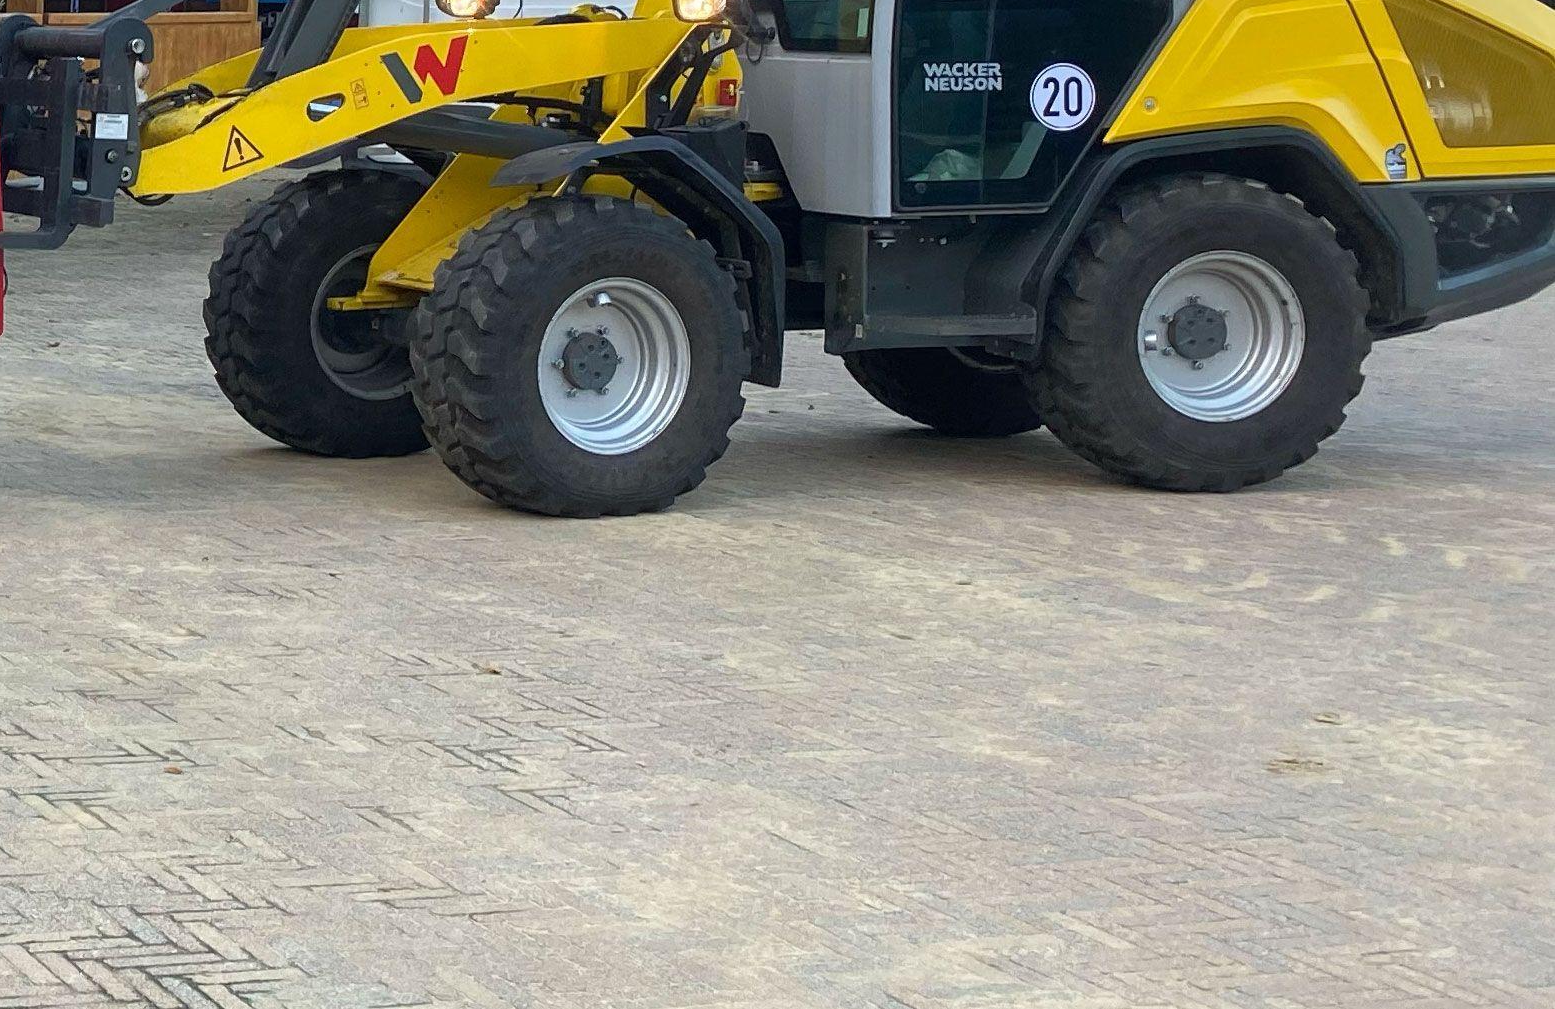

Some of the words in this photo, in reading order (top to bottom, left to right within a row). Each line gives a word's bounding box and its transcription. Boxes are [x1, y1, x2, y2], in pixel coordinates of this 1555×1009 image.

[923, 62, 1002, 77] WACKER
[924, 77, 1003, 92] NEUSON
[1042, 76, 1083, 117] 20
